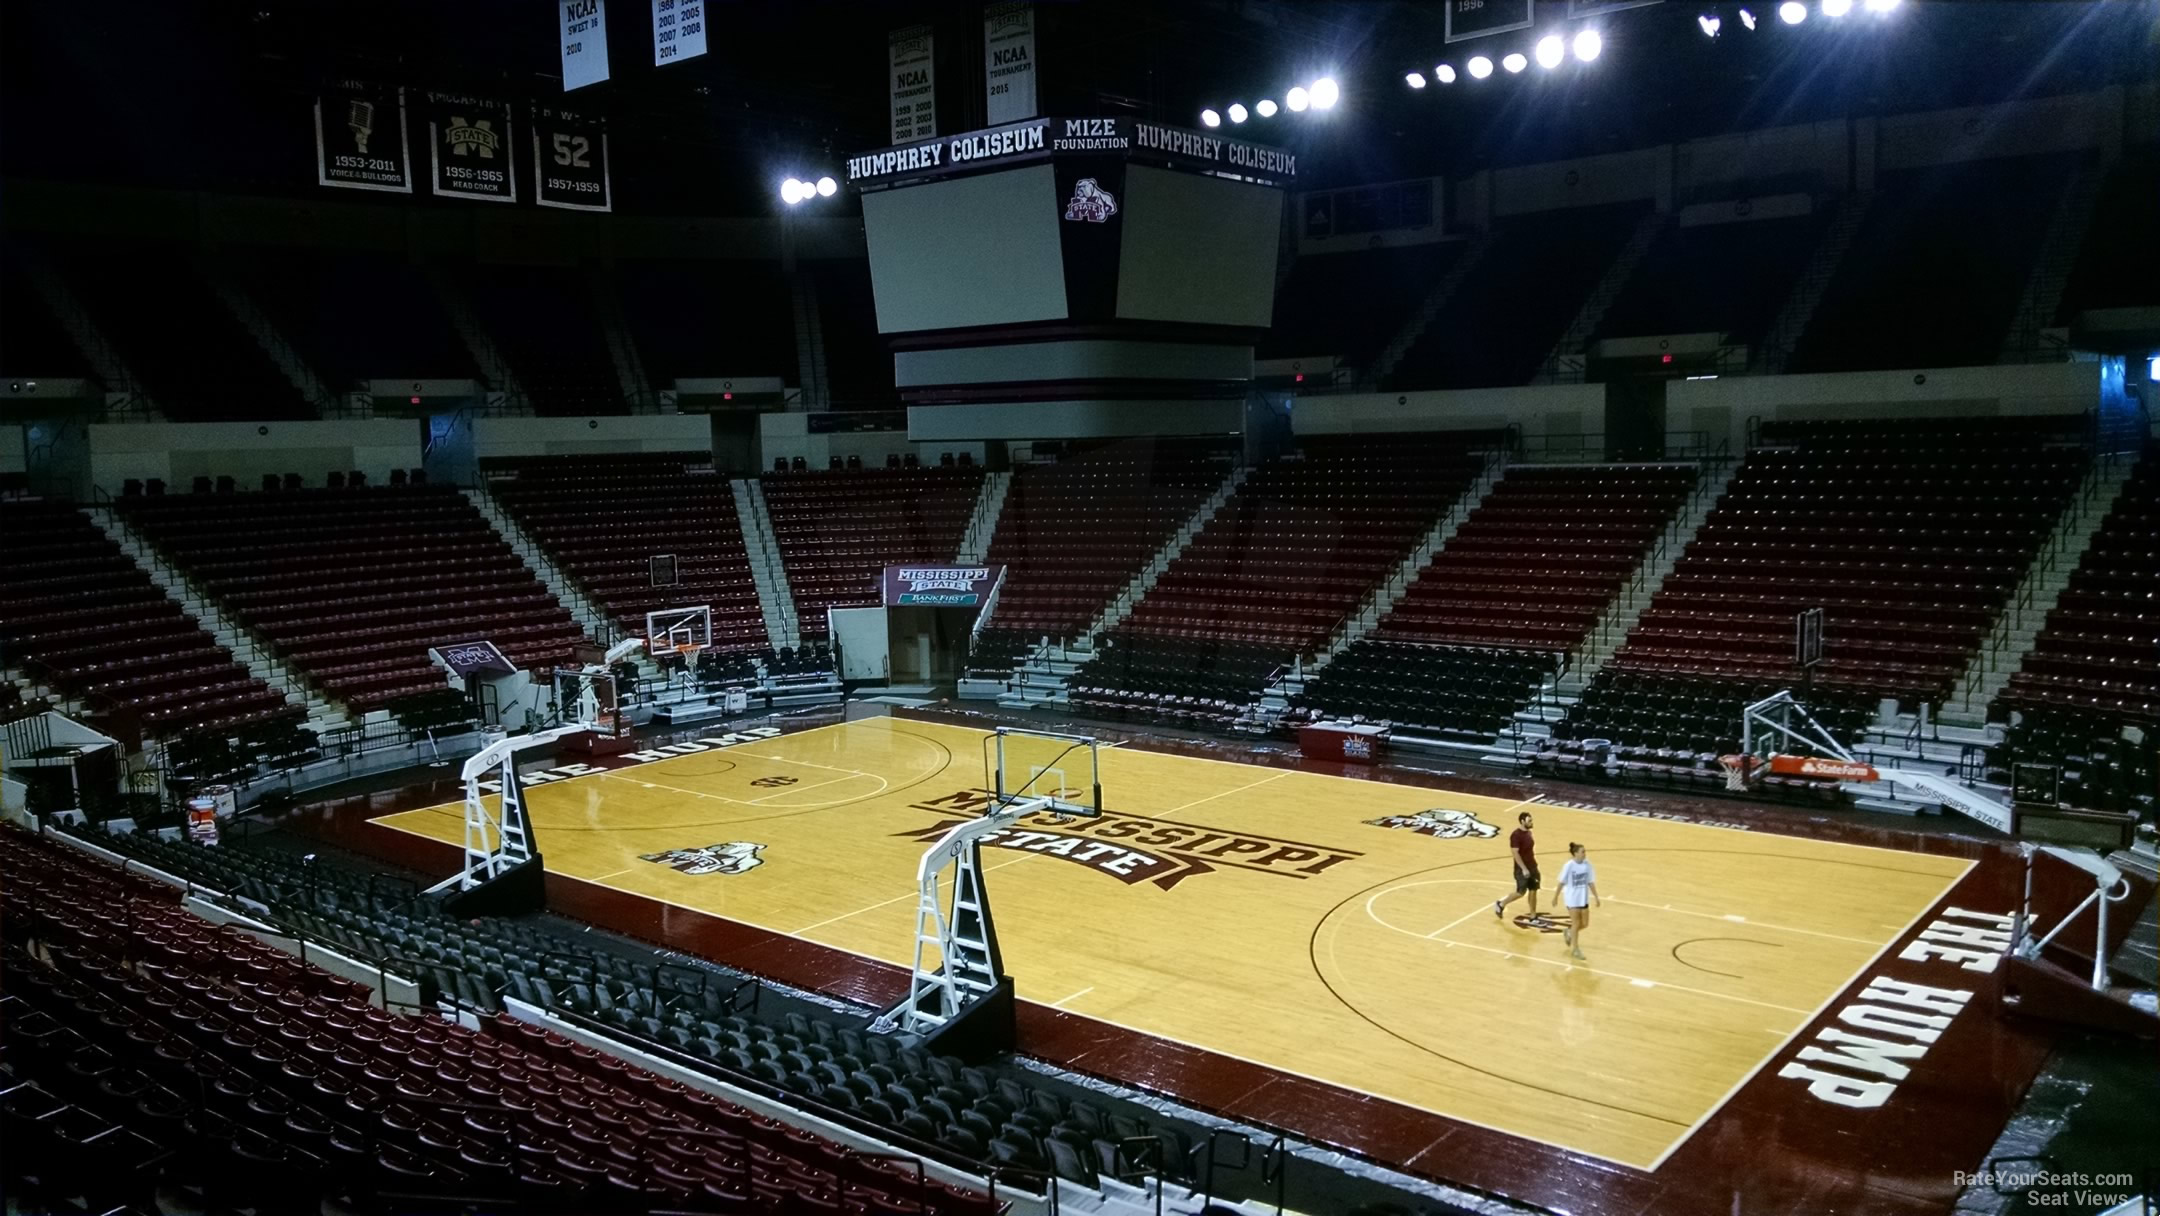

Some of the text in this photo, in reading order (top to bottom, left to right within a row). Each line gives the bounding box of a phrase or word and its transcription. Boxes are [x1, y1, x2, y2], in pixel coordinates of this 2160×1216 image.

[566, 0, 598, 22] NCAA
[659, 6, 700, 28] 2001 2005
[568, 17, 598, 35] SWEET 16
[659, 22, 701, 43] 2007 2008
[566, 42, 582, 56] 2010
[659, 47, 677, 59] 2014
[993, 45, 1027, 66] NCAA
[898, 69, 928, 89] NCAA
[990, 63, 1032, 79] TOURNAMENT
[894, 85, 932, 99] TOURNAMENT
[991, 84, 1009, 96] 2015
[895, 117, 912, 128] 2002
[917, 125, 932, 136] 2010
[1065, 118, 1116, 136] MIZE
[454, 129, 490, 144] STATE
[1053, 137, 1129, 150] FOUNDATION
[553, 132, 591, 168] 52
[850, 125, 1044, 179] HUMPHREY COLISEUM
[1136, 123, 1296, 175] HUMPHREY COLISEUM
[335, 155, 396, 172] 1953-2011
[329, 168, 355, 178] VOICE
[362, 171, 402, 182] BULLDOGS
[445, 166, 504, 182] 1956-1965
[452, 180, 499, 192] HEAD COACH
[547, 178, 600, 192] 1957-1959
[1073, 204, 1098, 212] STATE
[899, 569, 989, 580] MISSISSIPPI
[919, 580, 963, 589] STATE
[618, 727, 782, 762] HUMP
[1914, 783, 2005, 829] MISSISSIPPI STATE
[1778, 906, 2039, 1108] THE HUMP
